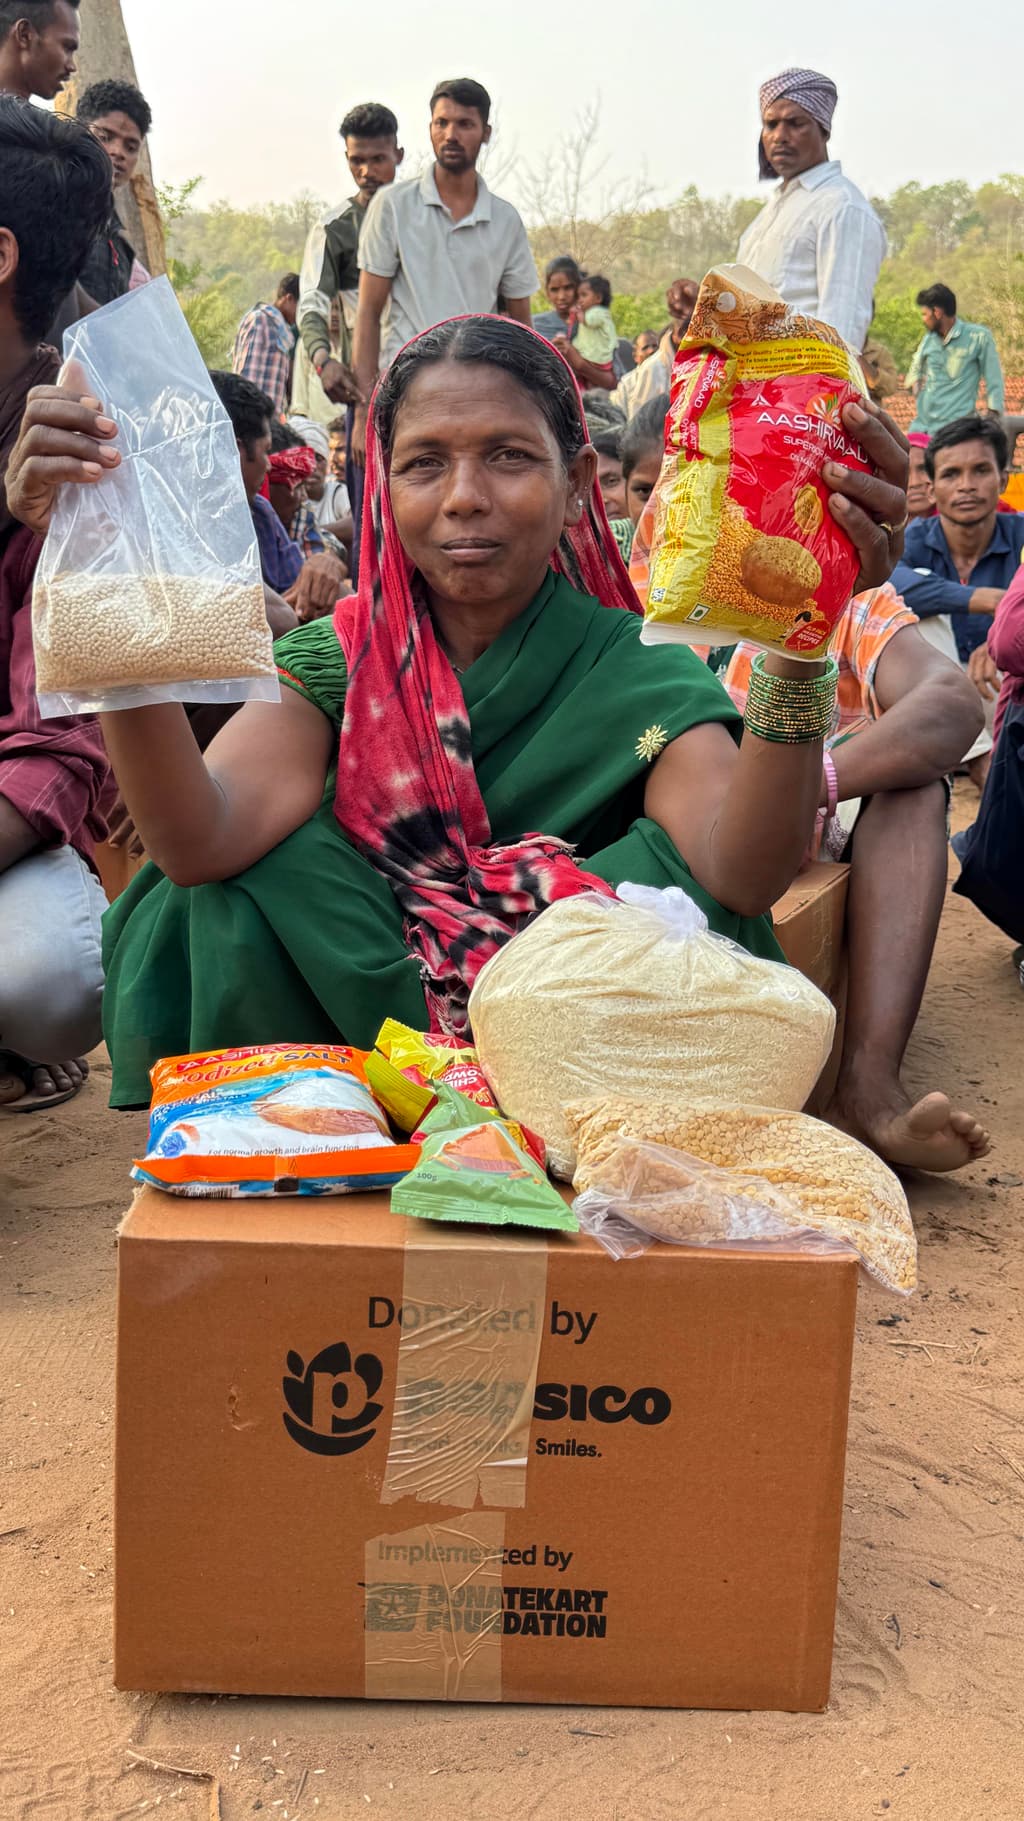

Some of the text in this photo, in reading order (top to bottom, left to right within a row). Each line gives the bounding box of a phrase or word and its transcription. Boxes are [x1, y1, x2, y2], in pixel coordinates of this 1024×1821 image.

[756, 411, 868, 464] AASHIRVAAD
[783, 435, 825, 456] SUPERIOR
[178, 1043, 347, 1072] AASHIRVAAD
[181, 1052, 350, 1083] odized SALT
[223, 1148, 252, 1156] normal
[254, 1147, 284, 1156] growth
[284, 1145, 301, 1155] and
[301, 1144, 323, 1154] brain
[325, 1143, 360, 1153] function
[416, 1172, 438, 1182] 100g
[550, 1301, 598, 1345] by
[535, 1438, 603, 1458] Smiles.
[543, 1545, 574, 1572] by
[428, 1584, 609, 1613] DONATEKART
[426, 1609, 607, 1639] FOUNDATION
